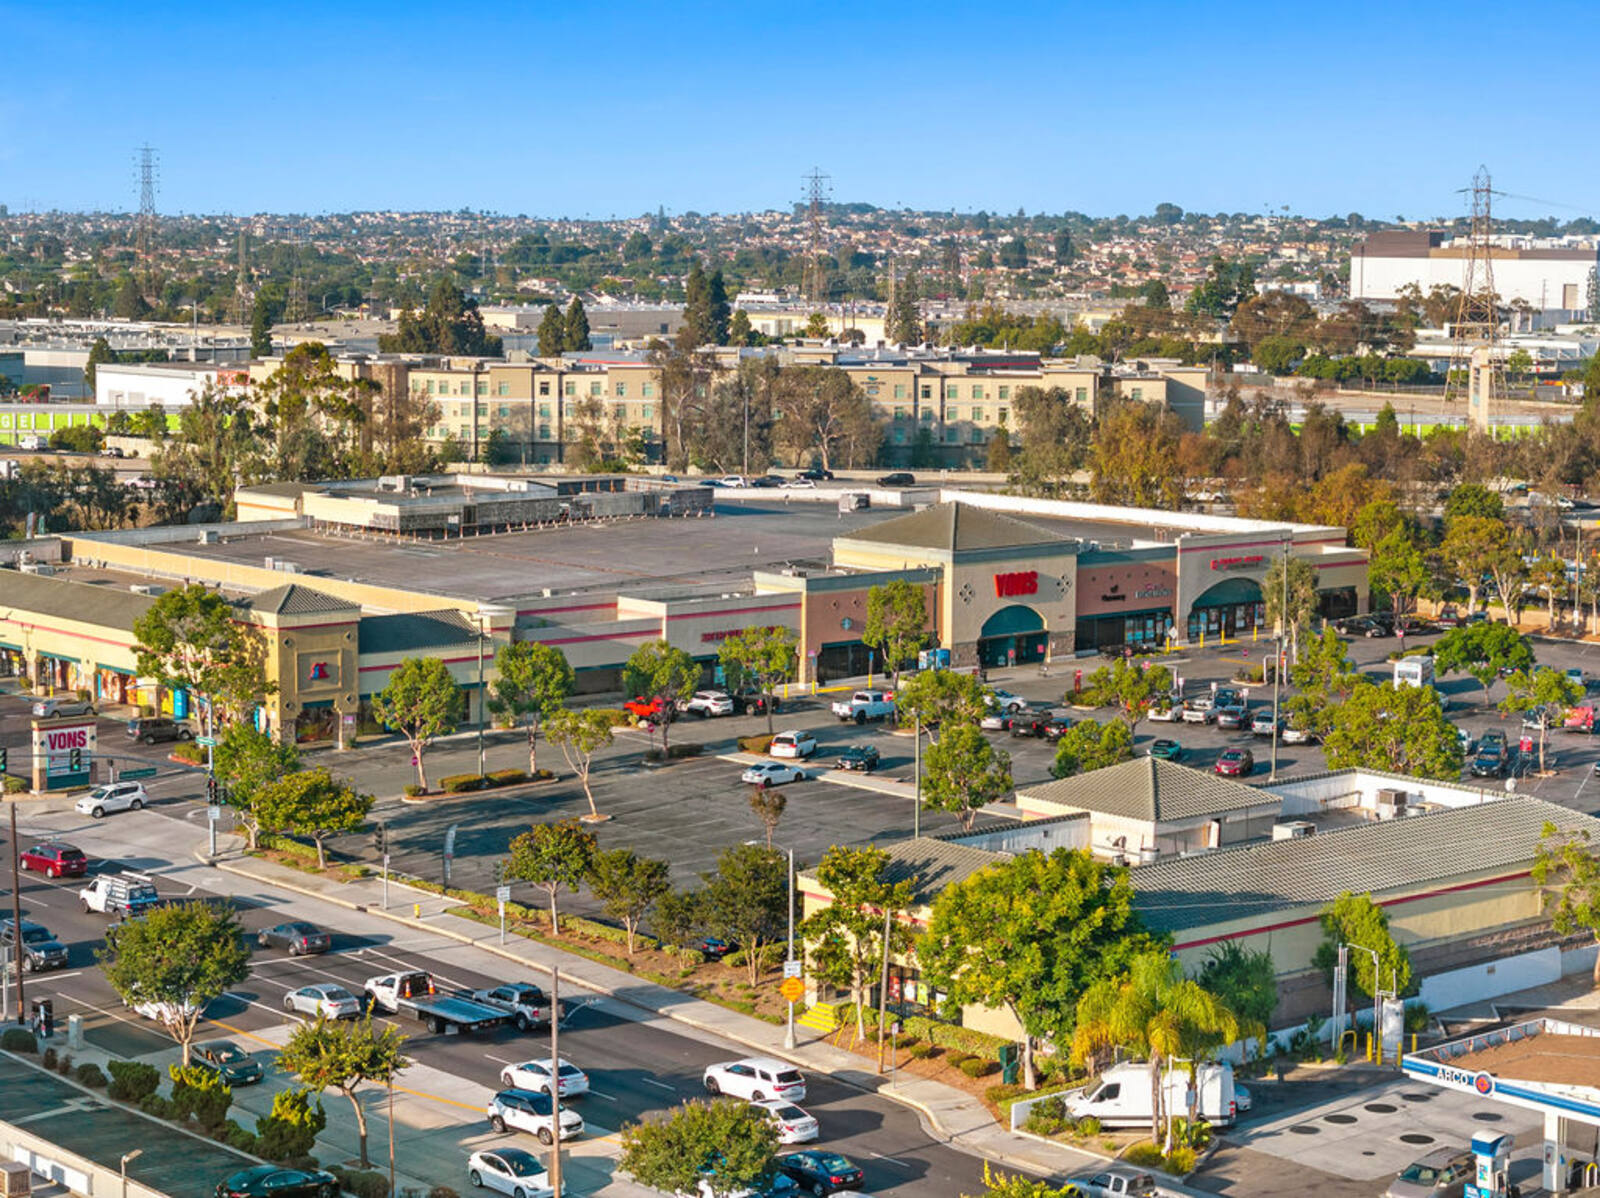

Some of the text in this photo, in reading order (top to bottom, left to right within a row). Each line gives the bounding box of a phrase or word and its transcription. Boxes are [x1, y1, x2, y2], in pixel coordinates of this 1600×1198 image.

[993, 570, 1039, 598] VONS
[48, 730, 87, 750] VONS
[1436, 1068, 1468, 1085] ARCO
